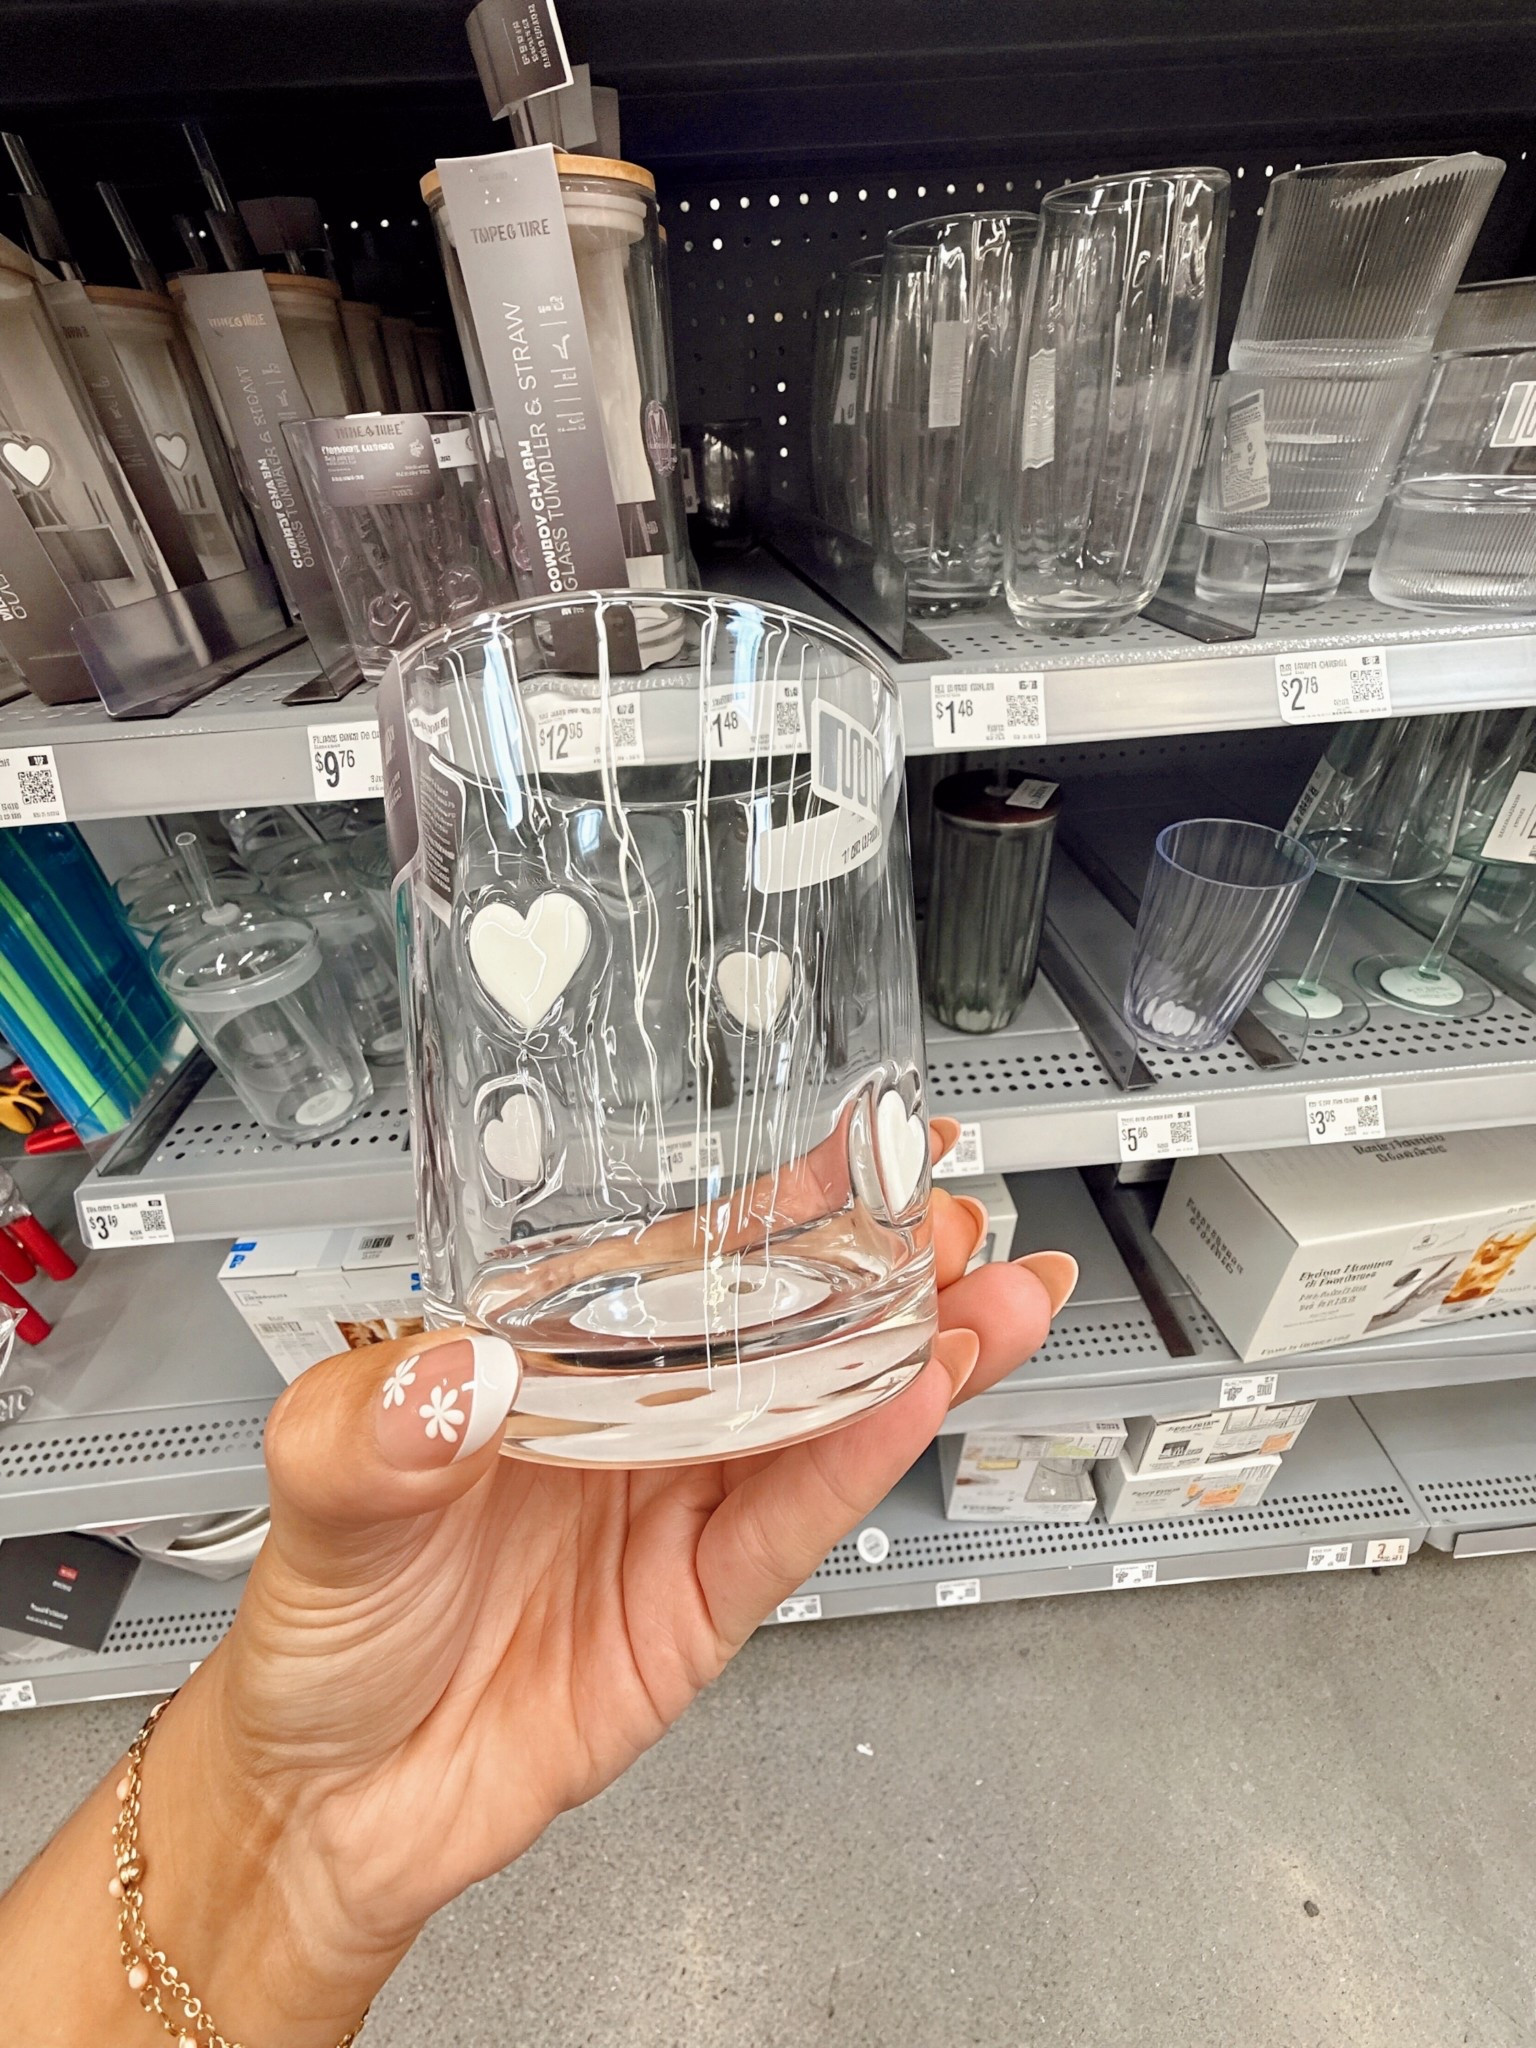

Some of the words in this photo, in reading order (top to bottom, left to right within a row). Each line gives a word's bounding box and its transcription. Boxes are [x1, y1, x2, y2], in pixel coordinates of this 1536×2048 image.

[502, 302, 537, 390] STRAW
[524, 397, 542, 416] &
[552, 527, 579, 592] GLASS
